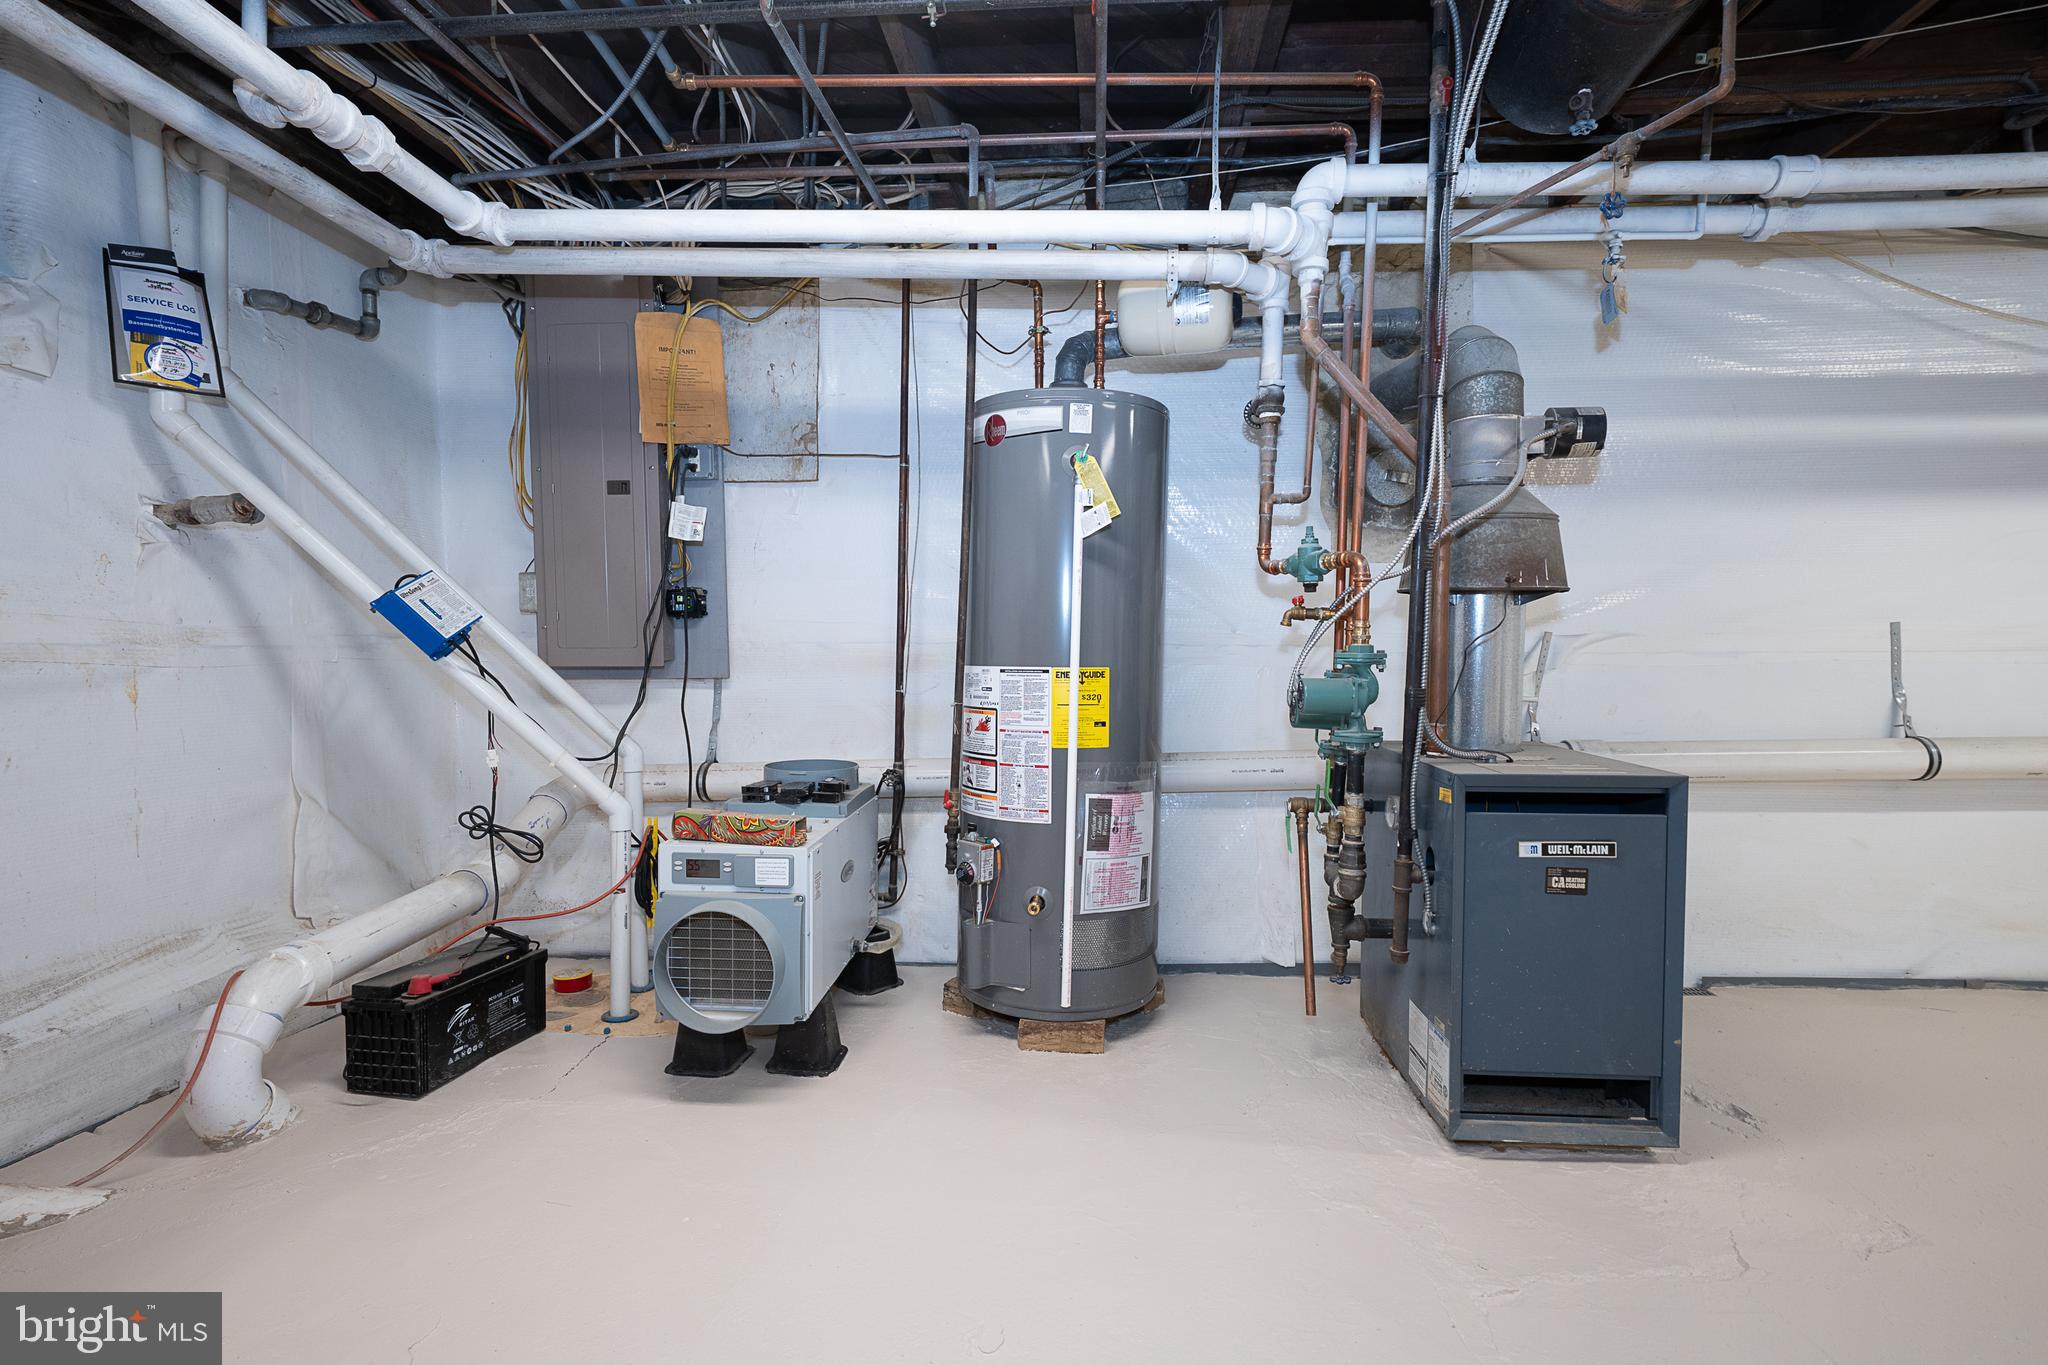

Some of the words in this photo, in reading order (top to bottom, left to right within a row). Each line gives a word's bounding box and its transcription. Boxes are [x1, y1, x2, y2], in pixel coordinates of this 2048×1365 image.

[127, 294, 174, 308] SERVICE
[177, 303, 196, 314] LOG
[986, 415, 1006, 441] Rheem
[1081, 693, 1102, 701] $320
[1551, 876, 1566, 888] CA
